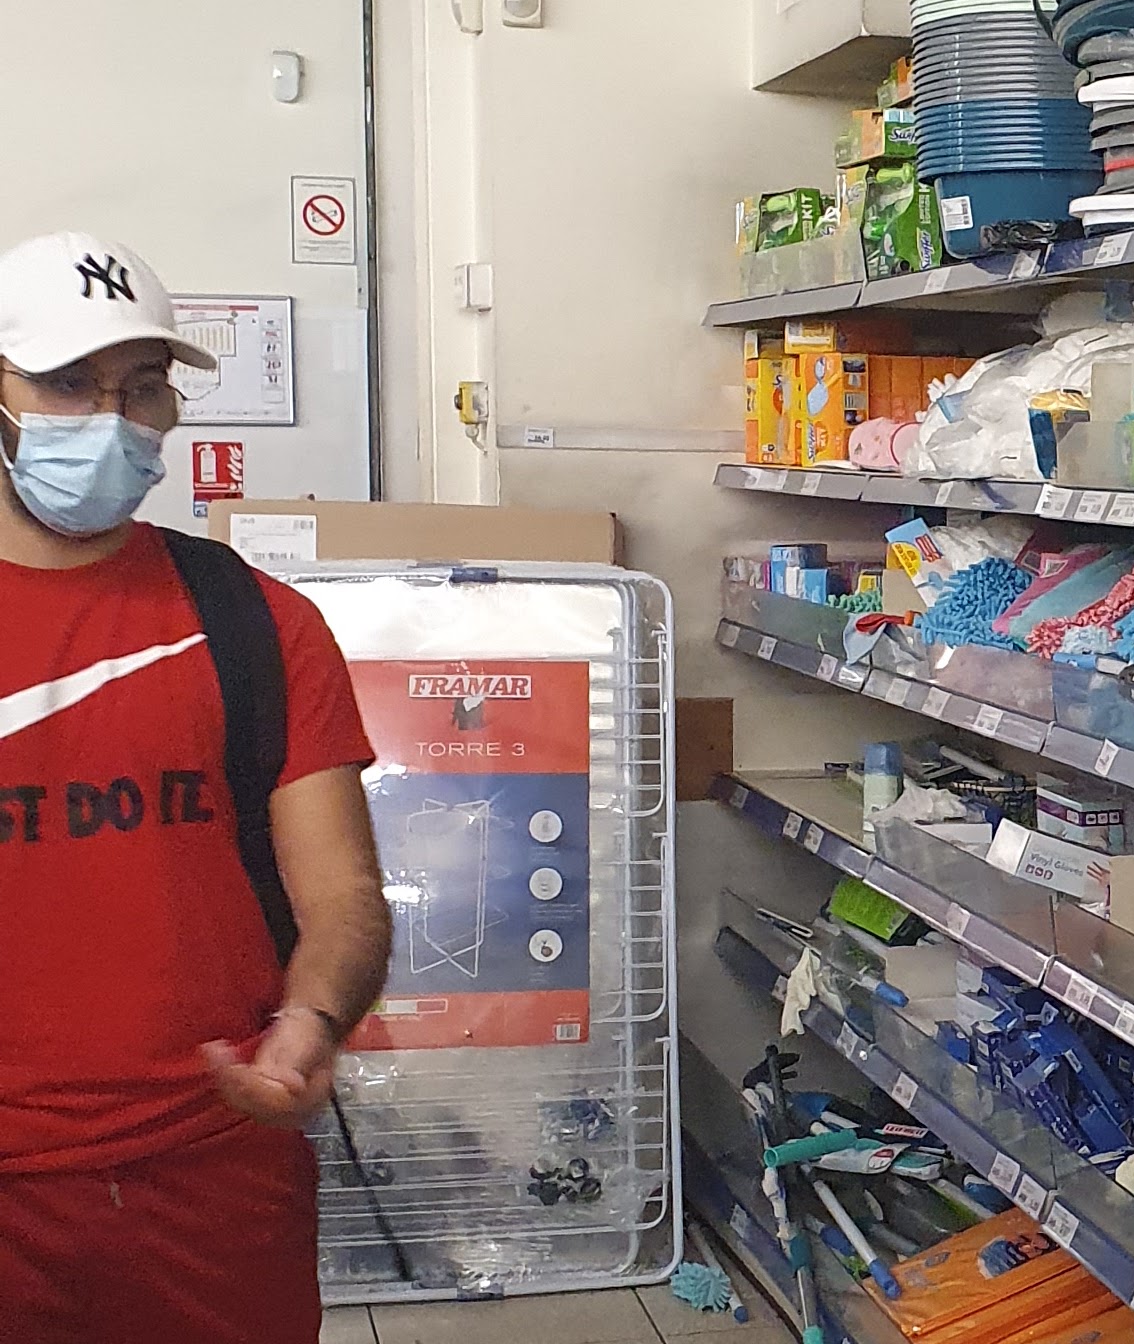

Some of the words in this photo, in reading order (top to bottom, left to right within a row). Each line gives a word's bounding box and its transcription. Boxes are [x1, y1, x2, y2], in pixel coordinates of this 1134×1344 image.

[801, 193, 812, 218] KIT
[411, 676, 529, 696] FRAMAR
[416, 742, 500, 757] TORRE
[512, 742, 526, 757] 3
[66, 776, 144, 839] DO
[1054, 859, 1084, 877] Gloves
